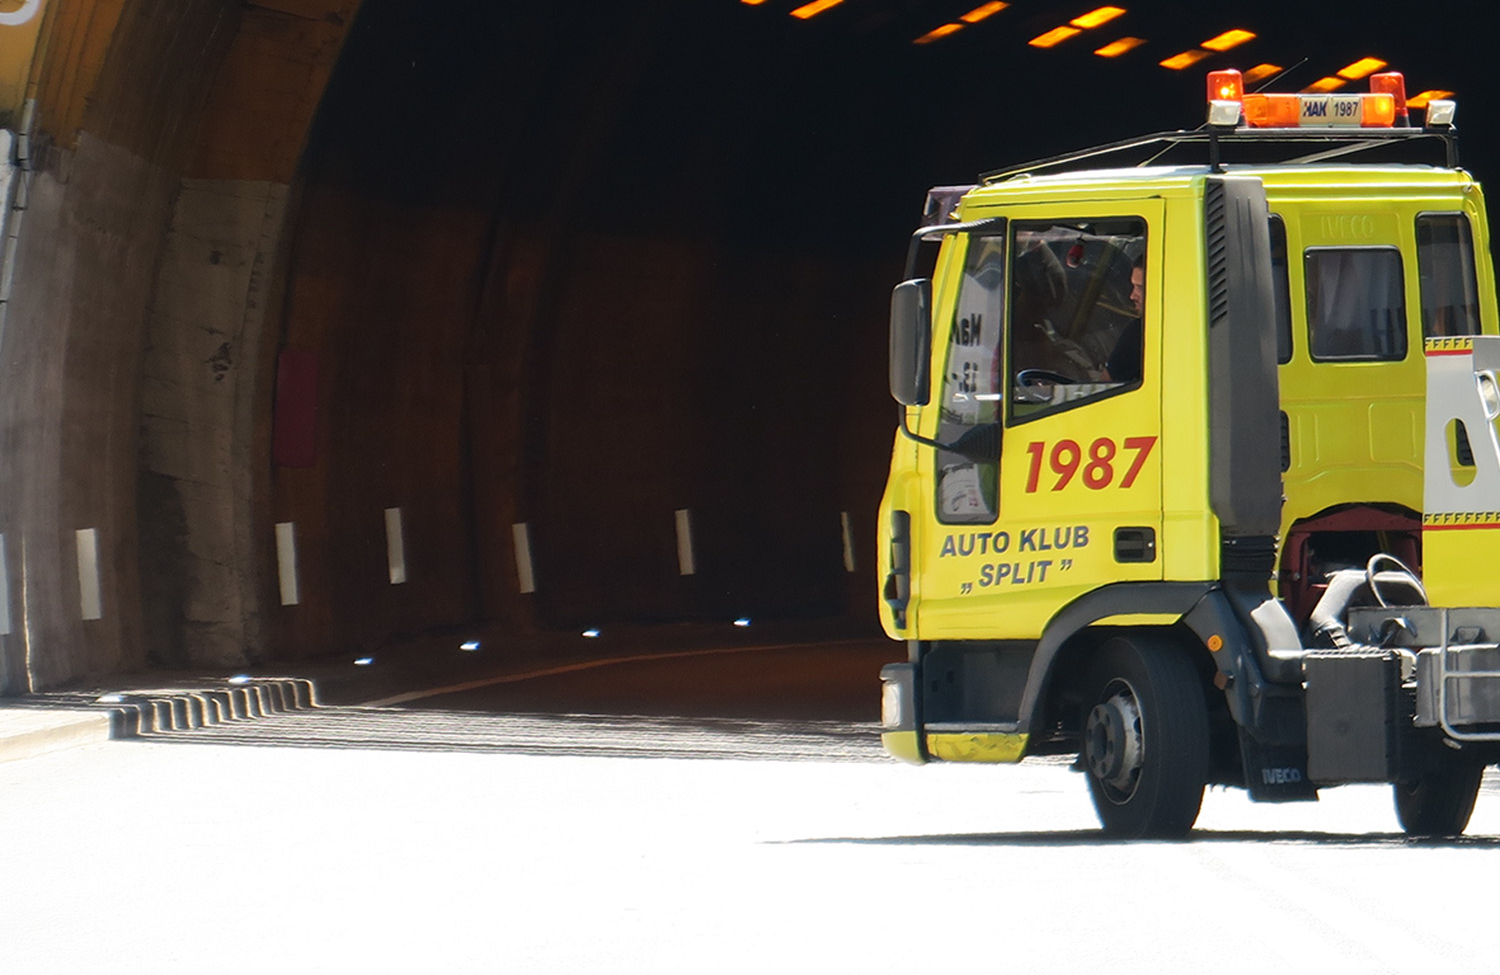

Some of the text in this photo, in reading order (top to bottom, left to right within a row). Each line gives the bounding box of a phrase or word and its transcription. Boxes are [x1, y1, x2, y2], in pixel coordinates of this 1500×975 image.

[1303, 102, 1358, 117] HAK 1987
[1025, 436, 1158, 493] 1987
[939, 526, 1090, 557] AUTO KLUB
[1262, 768, 1302, 784] IVECO
